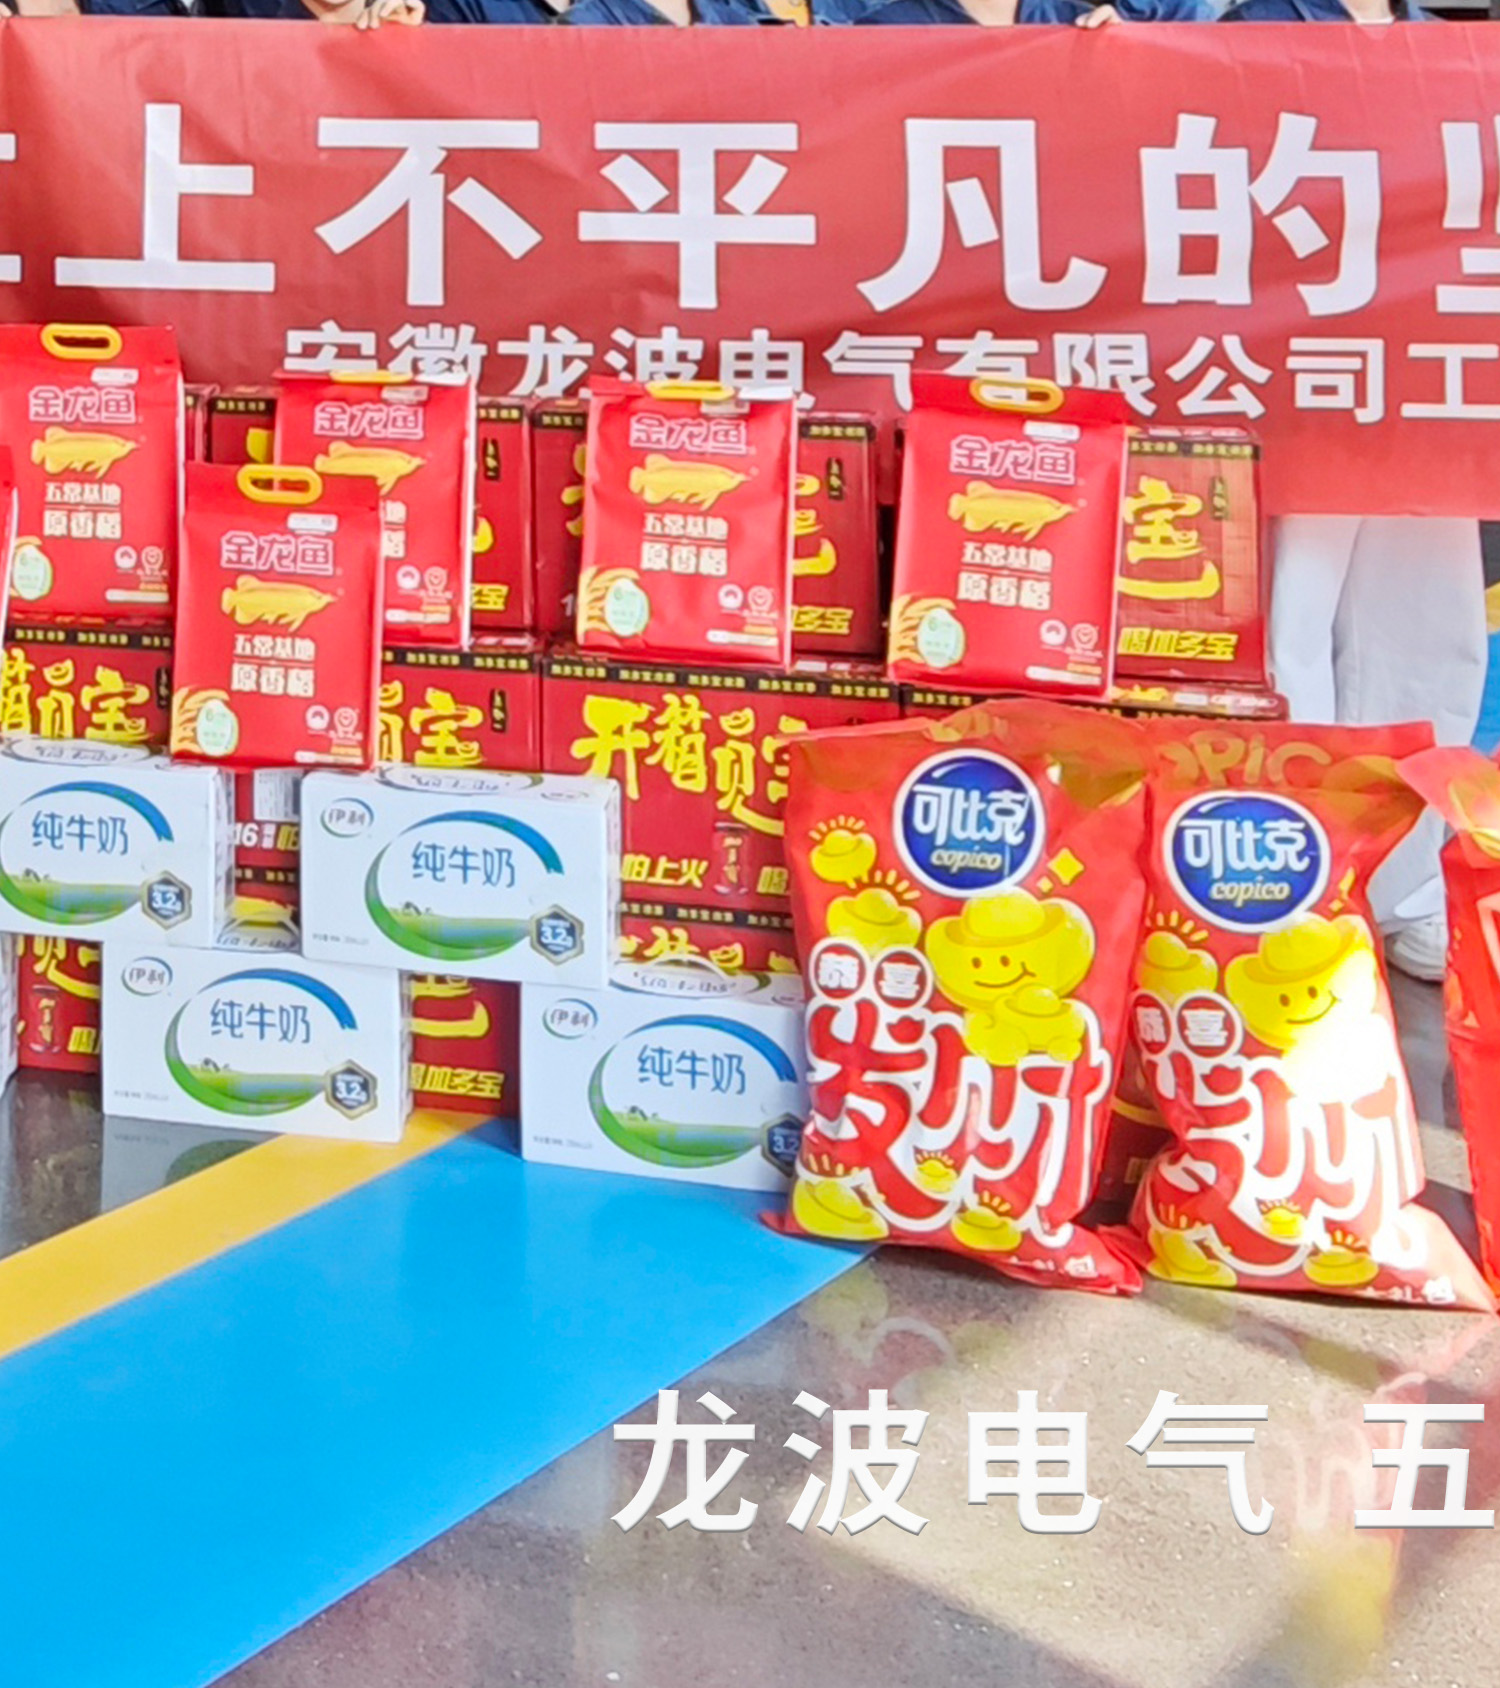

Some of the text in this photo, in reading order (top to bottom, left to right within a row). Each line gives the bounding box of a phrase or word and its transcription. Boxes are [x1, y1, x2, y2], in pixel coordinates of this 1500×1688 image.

[28, 386, 136, 424] 金龙鱼
[312, 401, 426, 440] 金龙鱼
[629, 413, 748, 455] 金龙鱼
[949, 434, 1077, 485] 金龙鱼
[43, 481, 122, 506] 五常基地
[643, 512, 729, 540] 五常基地
[219, 531, 335, 575] 金龙鱼
[962, 541, 1053, 572] 五常基地
[233, 634, 316, 661] 五常基地
[1117, 627, 1239, 662] 喝加多宝
[31, 809, 129, 856] 纯牛奶
[329, 806, 367, 827] 伊利
[913, 784, 1032, 847] 可比克
[929, 845, 1003, 873] copico
[1181, 820, 1312, 871] 可比克
[410, 841, 516, 889] 纯牛奶
[622, 853, 709, 888] 怕上火
[1210, 877, 1291, 904] copico
[128, 965, 168, 987] 伊利
[209, 998, 312, 1045] 纯牛奶
[549, 1006, 589, 1029] 伊利
[636, 1043, 746, 1096] 纯牛奶
